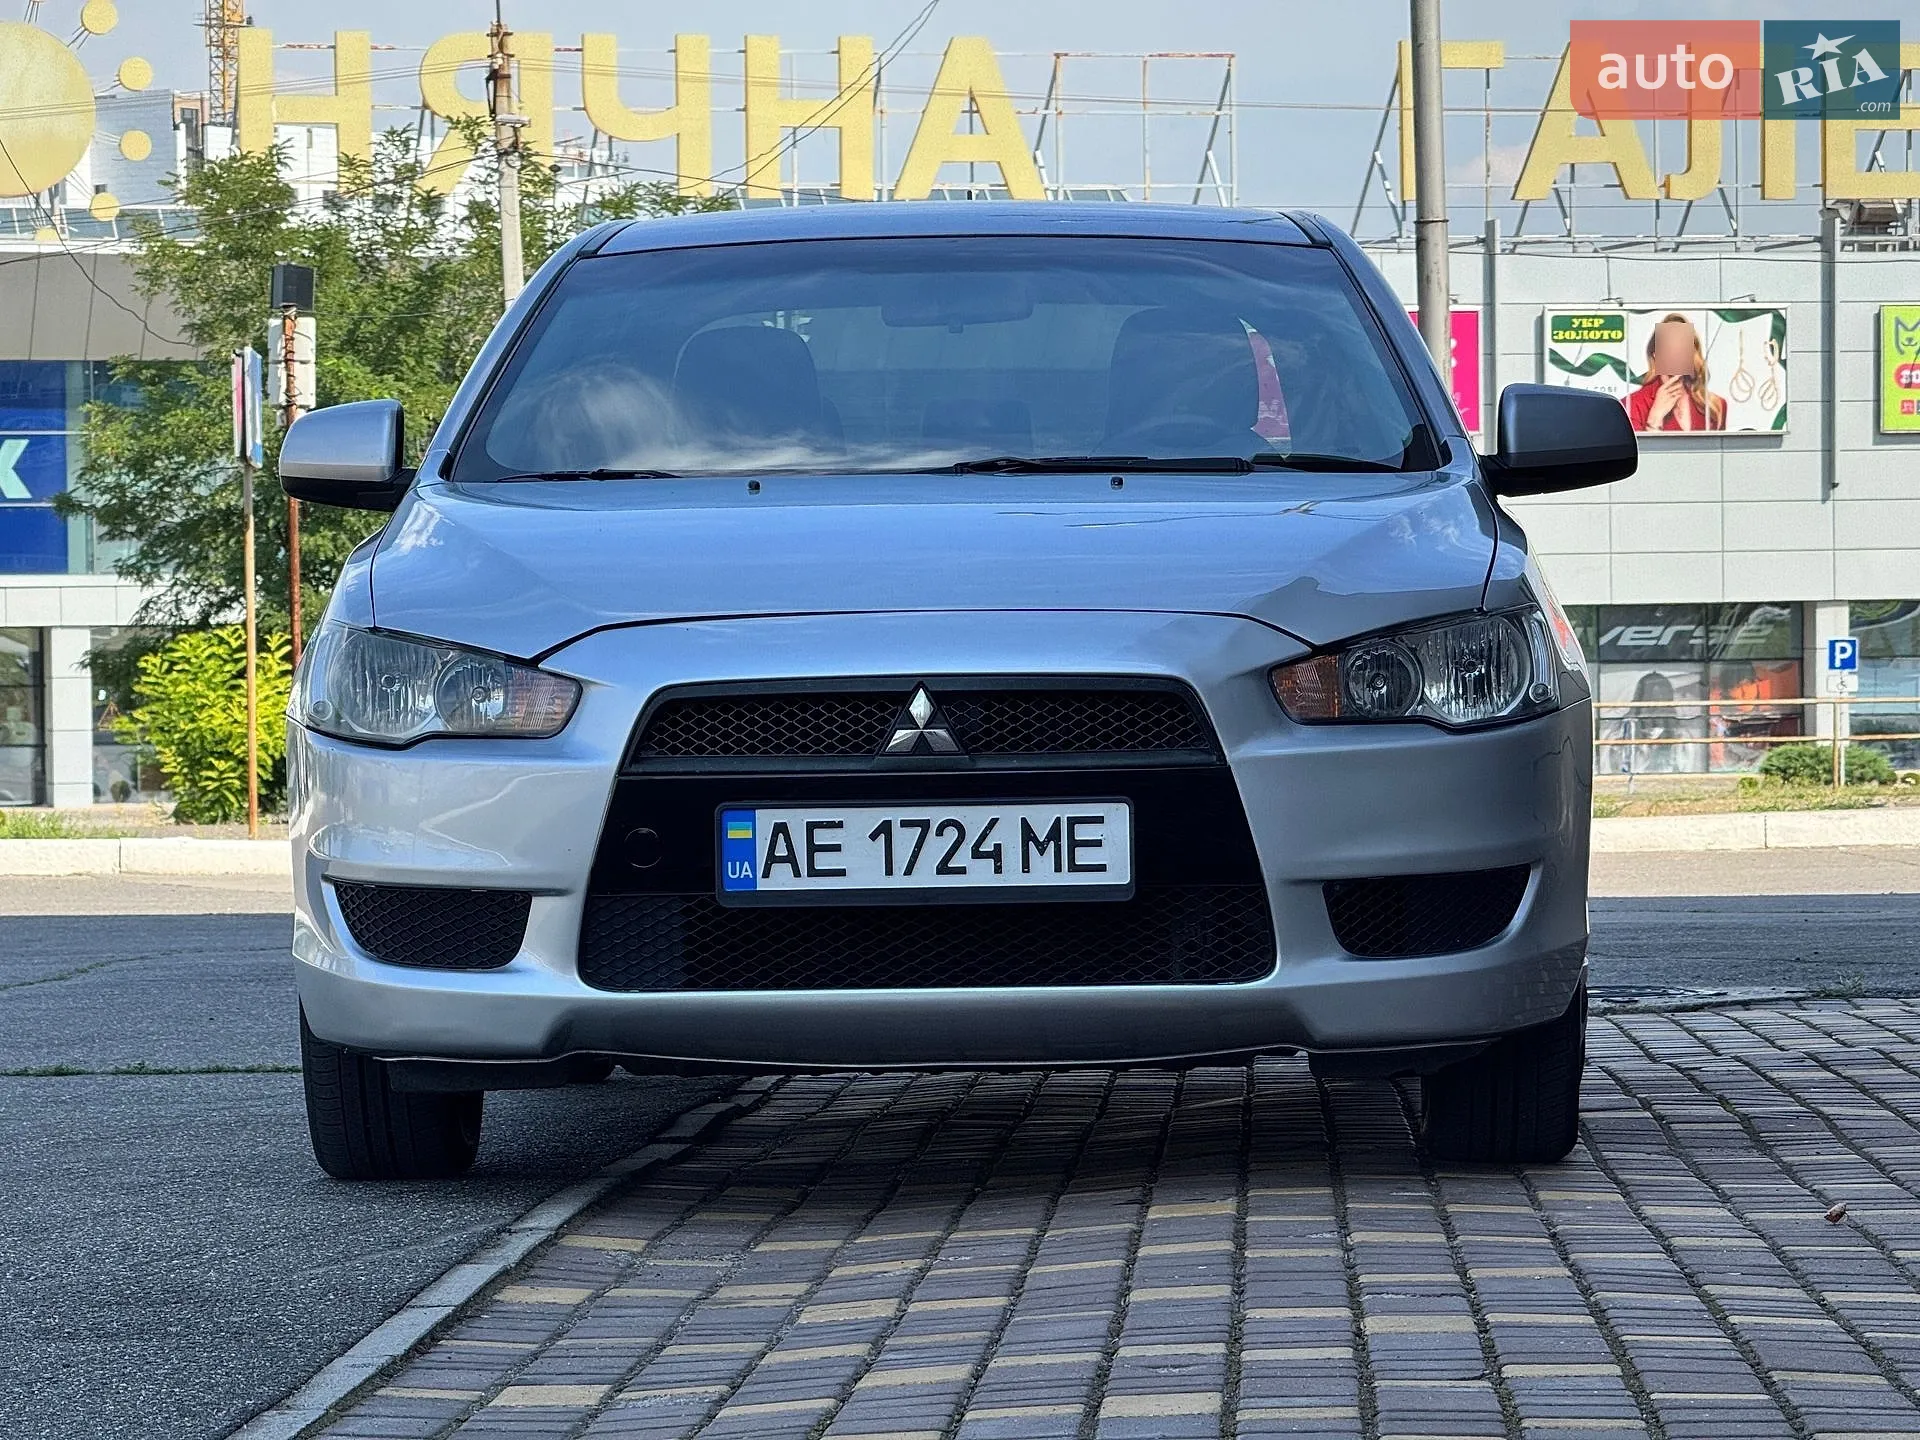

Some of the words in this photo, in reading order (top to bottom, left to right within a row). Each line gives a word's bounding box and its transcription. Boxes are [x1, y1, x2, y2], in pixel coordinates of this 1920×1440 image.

[1571, 317, 1605, 328] УКР
[1552, 329, 1623, 340] ЗОЛОТО
[1834, 641, 1853, 669] P
[761, 819, 847, 878] AE
[868, 817, 1003, 877] 1724
[1021, 815, 1107, 874] ME
[727, 861, 753, 878] UA
